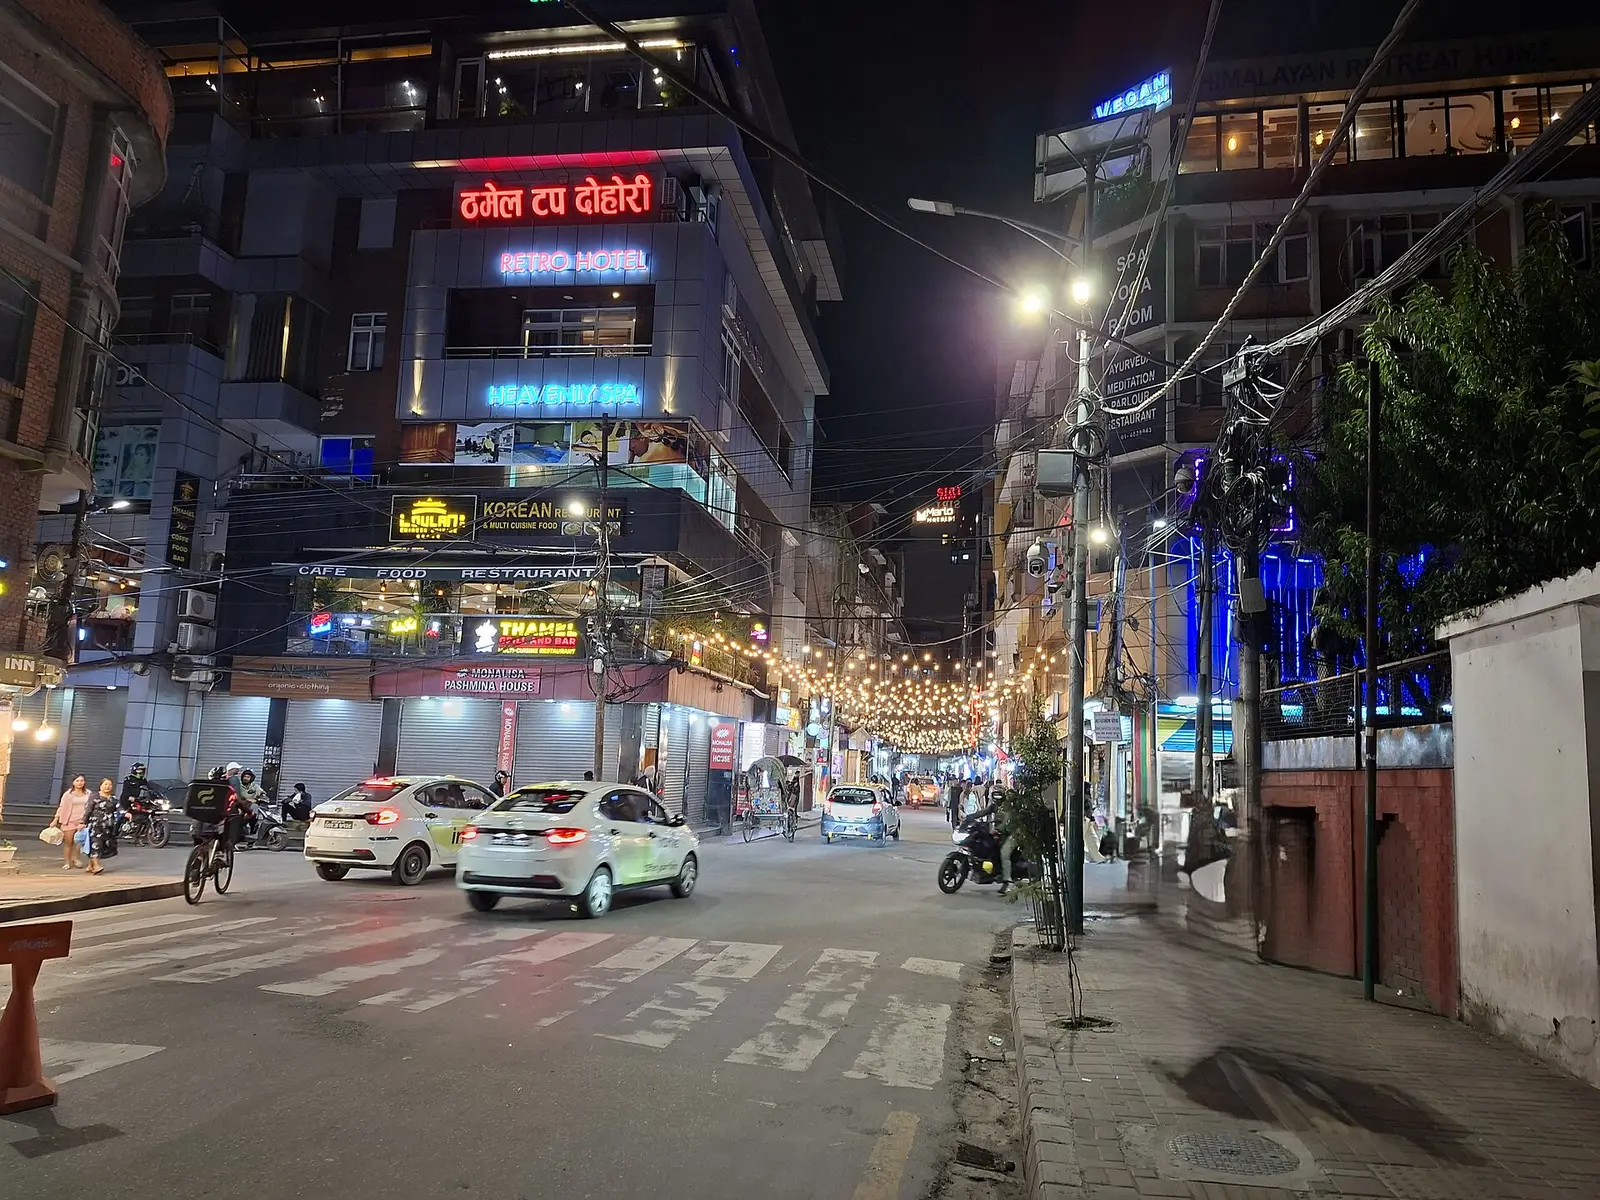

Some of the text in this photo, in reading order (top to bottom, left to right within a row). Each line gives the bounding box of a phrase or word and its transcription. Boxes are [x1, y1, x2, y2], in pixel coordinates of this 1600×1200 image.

[1345, 49, 1463, 80] RTREAT
[1095, 73, 1167, 118] VEGAN
[460, 174, 651, 219] ठमेल टप दोहोरी
[500, 250, 649, 274] RETRO HOTEL
[1116, 248, 1147, 273] SPA
[1107, 369, 1156, 396] MEDITATION
[489, 383, 641, 406] HEAVENLY SPA
[483, 502, 553, 519] KOREAN
[489, 521, 509, 529] MULTI
[510, 521, 537, 529] CUISINE
[538, 521, 558, 530] FOOD
[172, 543, 188, 553] FOOD
[172, 554, 185, 562] BAR
[298, 565, 597, 580] CAFE FOOD RESTAURANT
[499, 621, 578, 637] THAMEL
[529, 637, 552, 645] AND
[554, 637, 576, 646] BAR
[5, 657, 36, 672] INN
[471, 668, 526, 679] MONALISA
[444, 680, 535, 692] PASHMINA HOUSE
[712, 755, 731, 763] HOUSE
